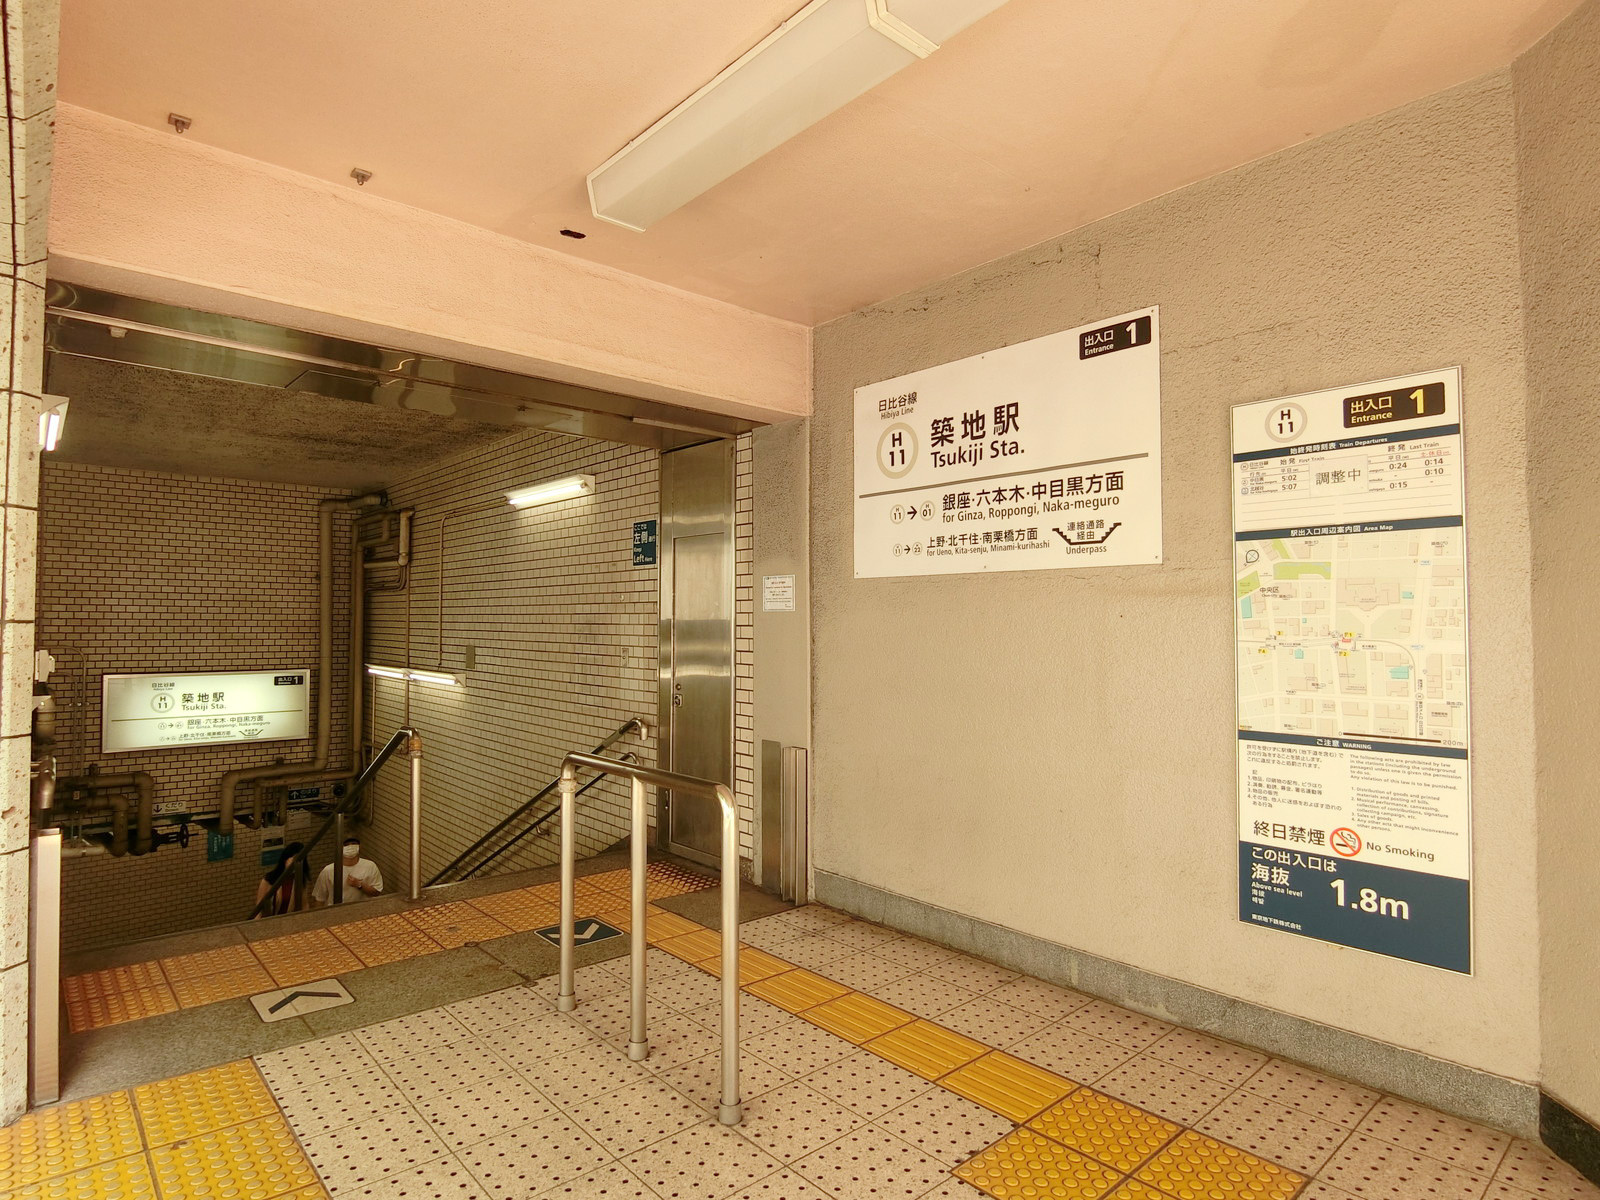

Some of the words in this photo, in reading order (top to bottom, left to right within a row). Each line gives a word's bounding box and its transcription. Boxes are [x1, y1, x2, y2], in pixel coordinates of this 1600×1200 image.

[1084, 330, 1114, 348] 出入口
[1126, 322, 1137, 344] 1
[1085, 343, 1114, 356] Entrance
[879, 391, 918, 412] 日比谷線
[1351, 396, 1392, 414] 出入口
[1410, 389, 1424, 414] 1
[880, 409, 900, 420] Hibiya
[901, 406, 914, 415] Line
[1281, 409, 1290, 420] H
[1351, 411, 1392, 424] Entrance
[931, 402, 1020, 447] 築地駅
[1278, 422, 1294, 434] 11
[892, 432, 902, 447] H
[1355, 437, 1388, 446] Departures
[931, 443, 983, 468] Tsukiji
[990, 439, 1024, 459] Sta.
[1290, 442, 1336, 455] 始終発時刻表
[889, 449, 905, 466] 11
[1425, 458, 1443, 466] 0:14
[1389, 462, 1407, 470] 0:24
[1425, 468, 1444, 476] 0:10
[1315, 468, 1361, 485] 調整中
[1390, 481, 1407, 489] 0:15
[922, 507, 932, 517] 01
[943, 511, 954, 523] for
[957, 508, 986, 521] Ginza,
[989, 503, 1039, 521] Roppongi,
[1043, 495, 1119, 513] Naka-meguro
[1067, 519, 1105, 531] 連絡通路
[1076, 530, 1095, 541] 経由
[927, 547, 935, 556] for
[936, 546, 953, 556] Ueno,
[955, 542, 988, 556] Kita-senju,
[991, 540, 1050, 552] Minami-kurihashi
[1066, 544, 1107, 556] Underpass
[634, 554, 644, 563] Left
[294, 676, 298, 684] 1
[182, 692, 224, 703] 築地駅
[1316, 739, 1339, 747] ご注意
[1342, 742, 1372, 750] WARNING
[1253, 820, 1325, 846] 終日禁煙
[1367, 842, 1381, 852] No
[1385, 845, 1435, 862] Smoking
[1252, 847, 1337, 872] この出入口は
[1251, 863, 1290, 886] 海抜
[1252, 882, 1272, 891] Above
[1287, 888, 1303, 897] level
[1330, 879, 1409, 920] 1.8m
[1252, 914, 1301, 930] 東京地下鉄株式会社
